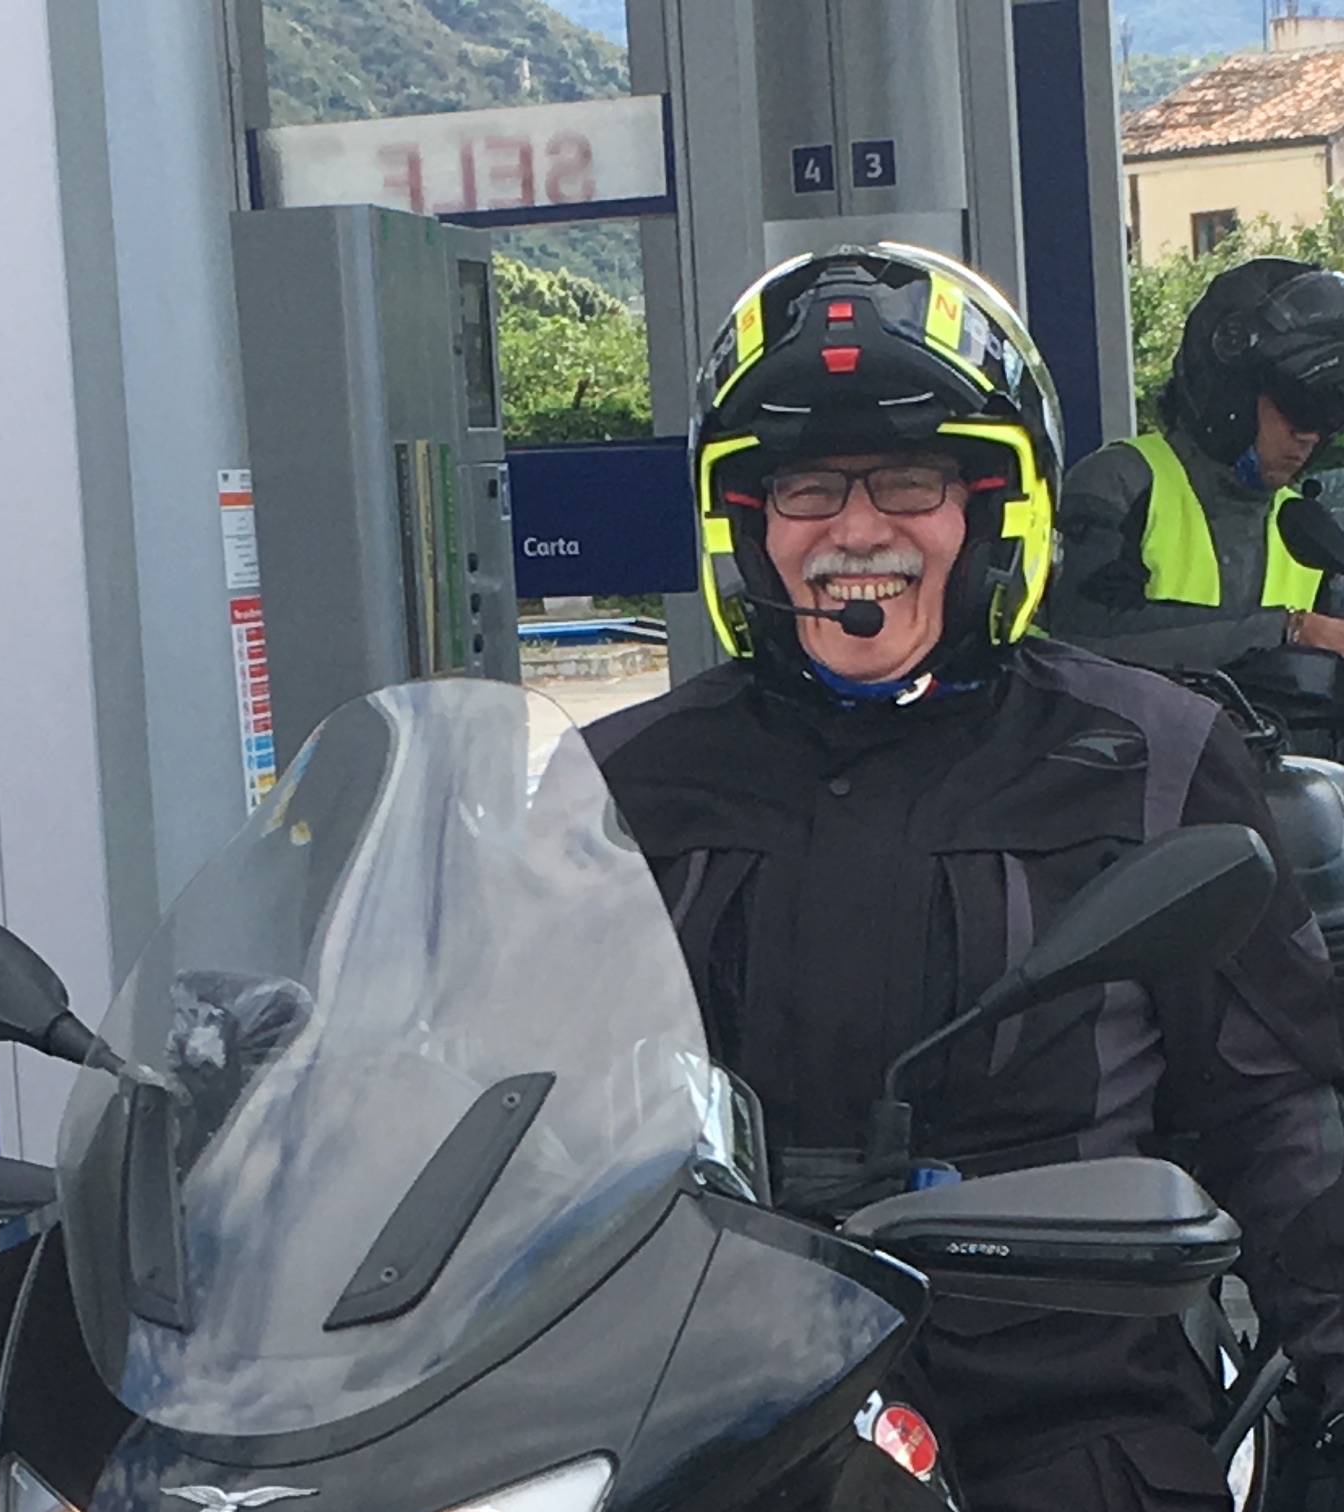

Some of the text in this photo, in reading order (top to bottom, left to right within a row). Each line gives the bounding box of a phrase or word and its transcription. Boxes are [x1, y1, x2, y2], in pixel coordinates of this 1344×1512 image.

[804, 158, 821, 183] 4
[864, 152, 883, 178] 3
[523, 536, 581, 557] Carta
